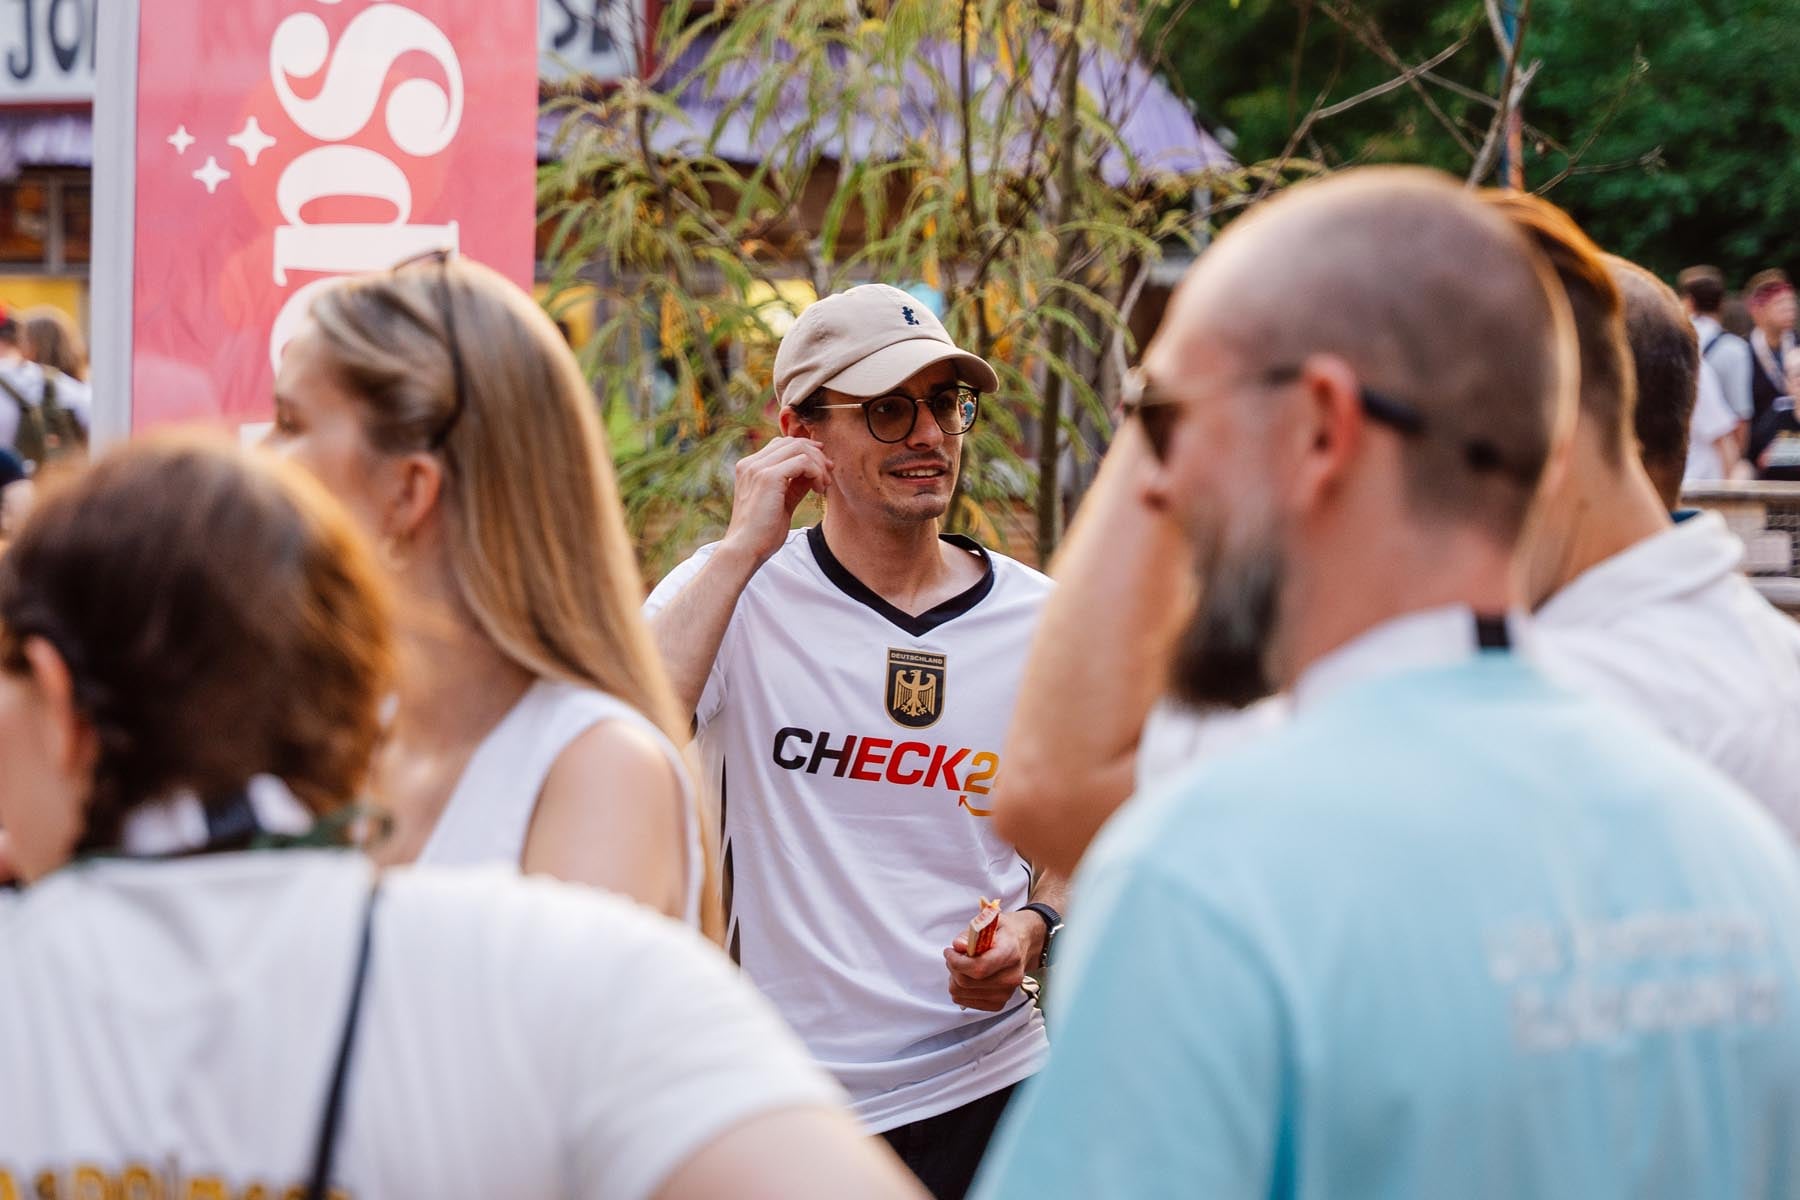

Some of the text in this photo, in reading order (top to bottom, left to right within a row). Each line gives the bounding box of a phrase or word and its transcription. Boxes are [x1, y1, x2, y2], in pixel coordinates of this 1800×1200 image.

[7, 0, 97, 80] JO
[890, 652, 943, 665] DEUTSCHLAND
[772, 726, 1000, 796] CHECK2
